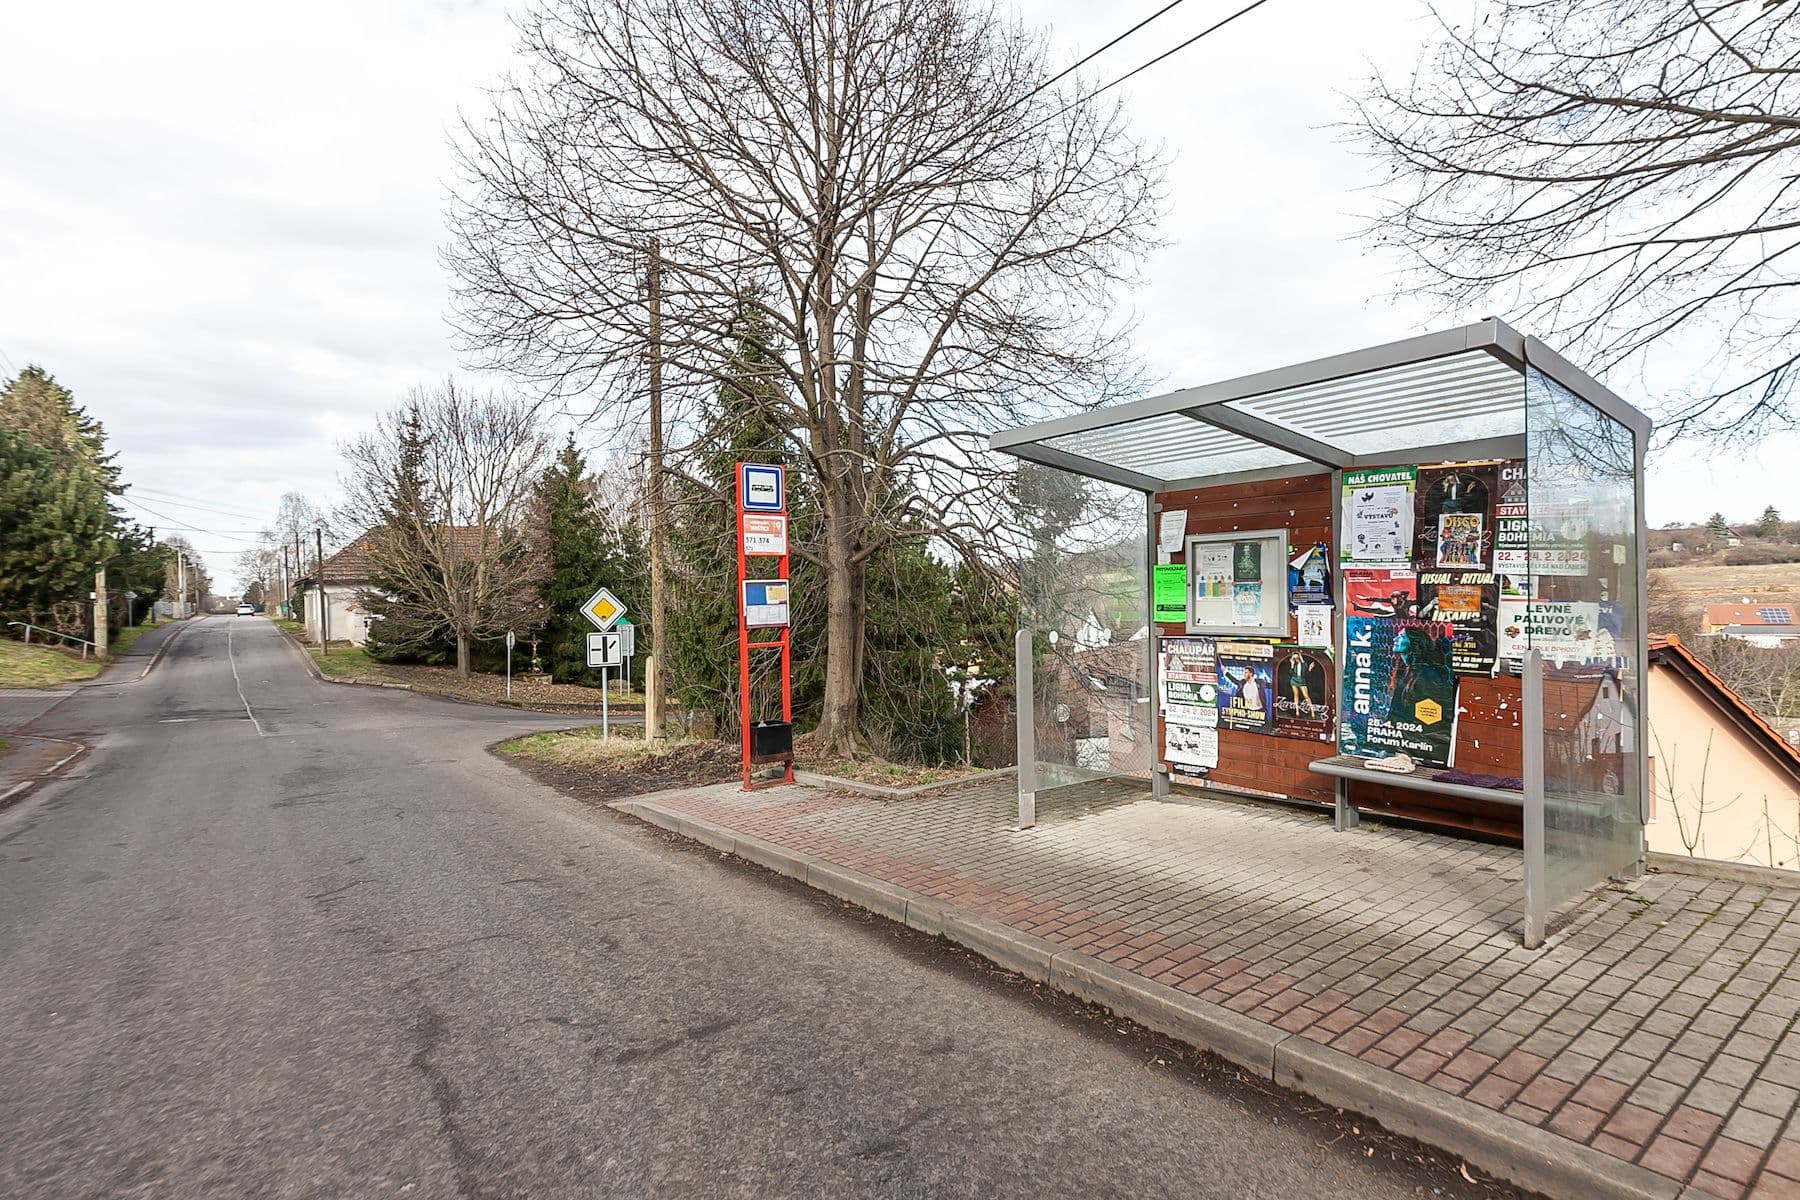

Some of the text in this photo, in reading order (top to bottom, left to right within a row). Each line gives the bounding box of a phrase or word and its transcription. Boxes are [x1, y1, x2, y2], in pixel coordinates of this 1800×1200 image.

[1348, 472, 1412, 484] NÁŠ CHOVATEL
[1444, 516, 1480, 528] DISCO
[1498, 551, 1514, 561] 22.
[1545, 552, 1555, 561] 2.
[1421, 573, 1451, 584] VISUAL
[1460, 573, 1495, 584] RITUAL
[1526, 604, 1572, 614] LEVNÉ
[1514, 615, 1585, 625] PALIVOVÉ
[1524, 626, 1572, 636] DŘEVO
[1167, 643, 1215, 656] CHALUPÁŘ
[1350, 624, 1372, 715] anna k.
[1367, 726, 1403, 739] PRAHA
[1395, 721, 1423, 733] 2024
[1367, 734, 1433, 752] Forum Karlín
